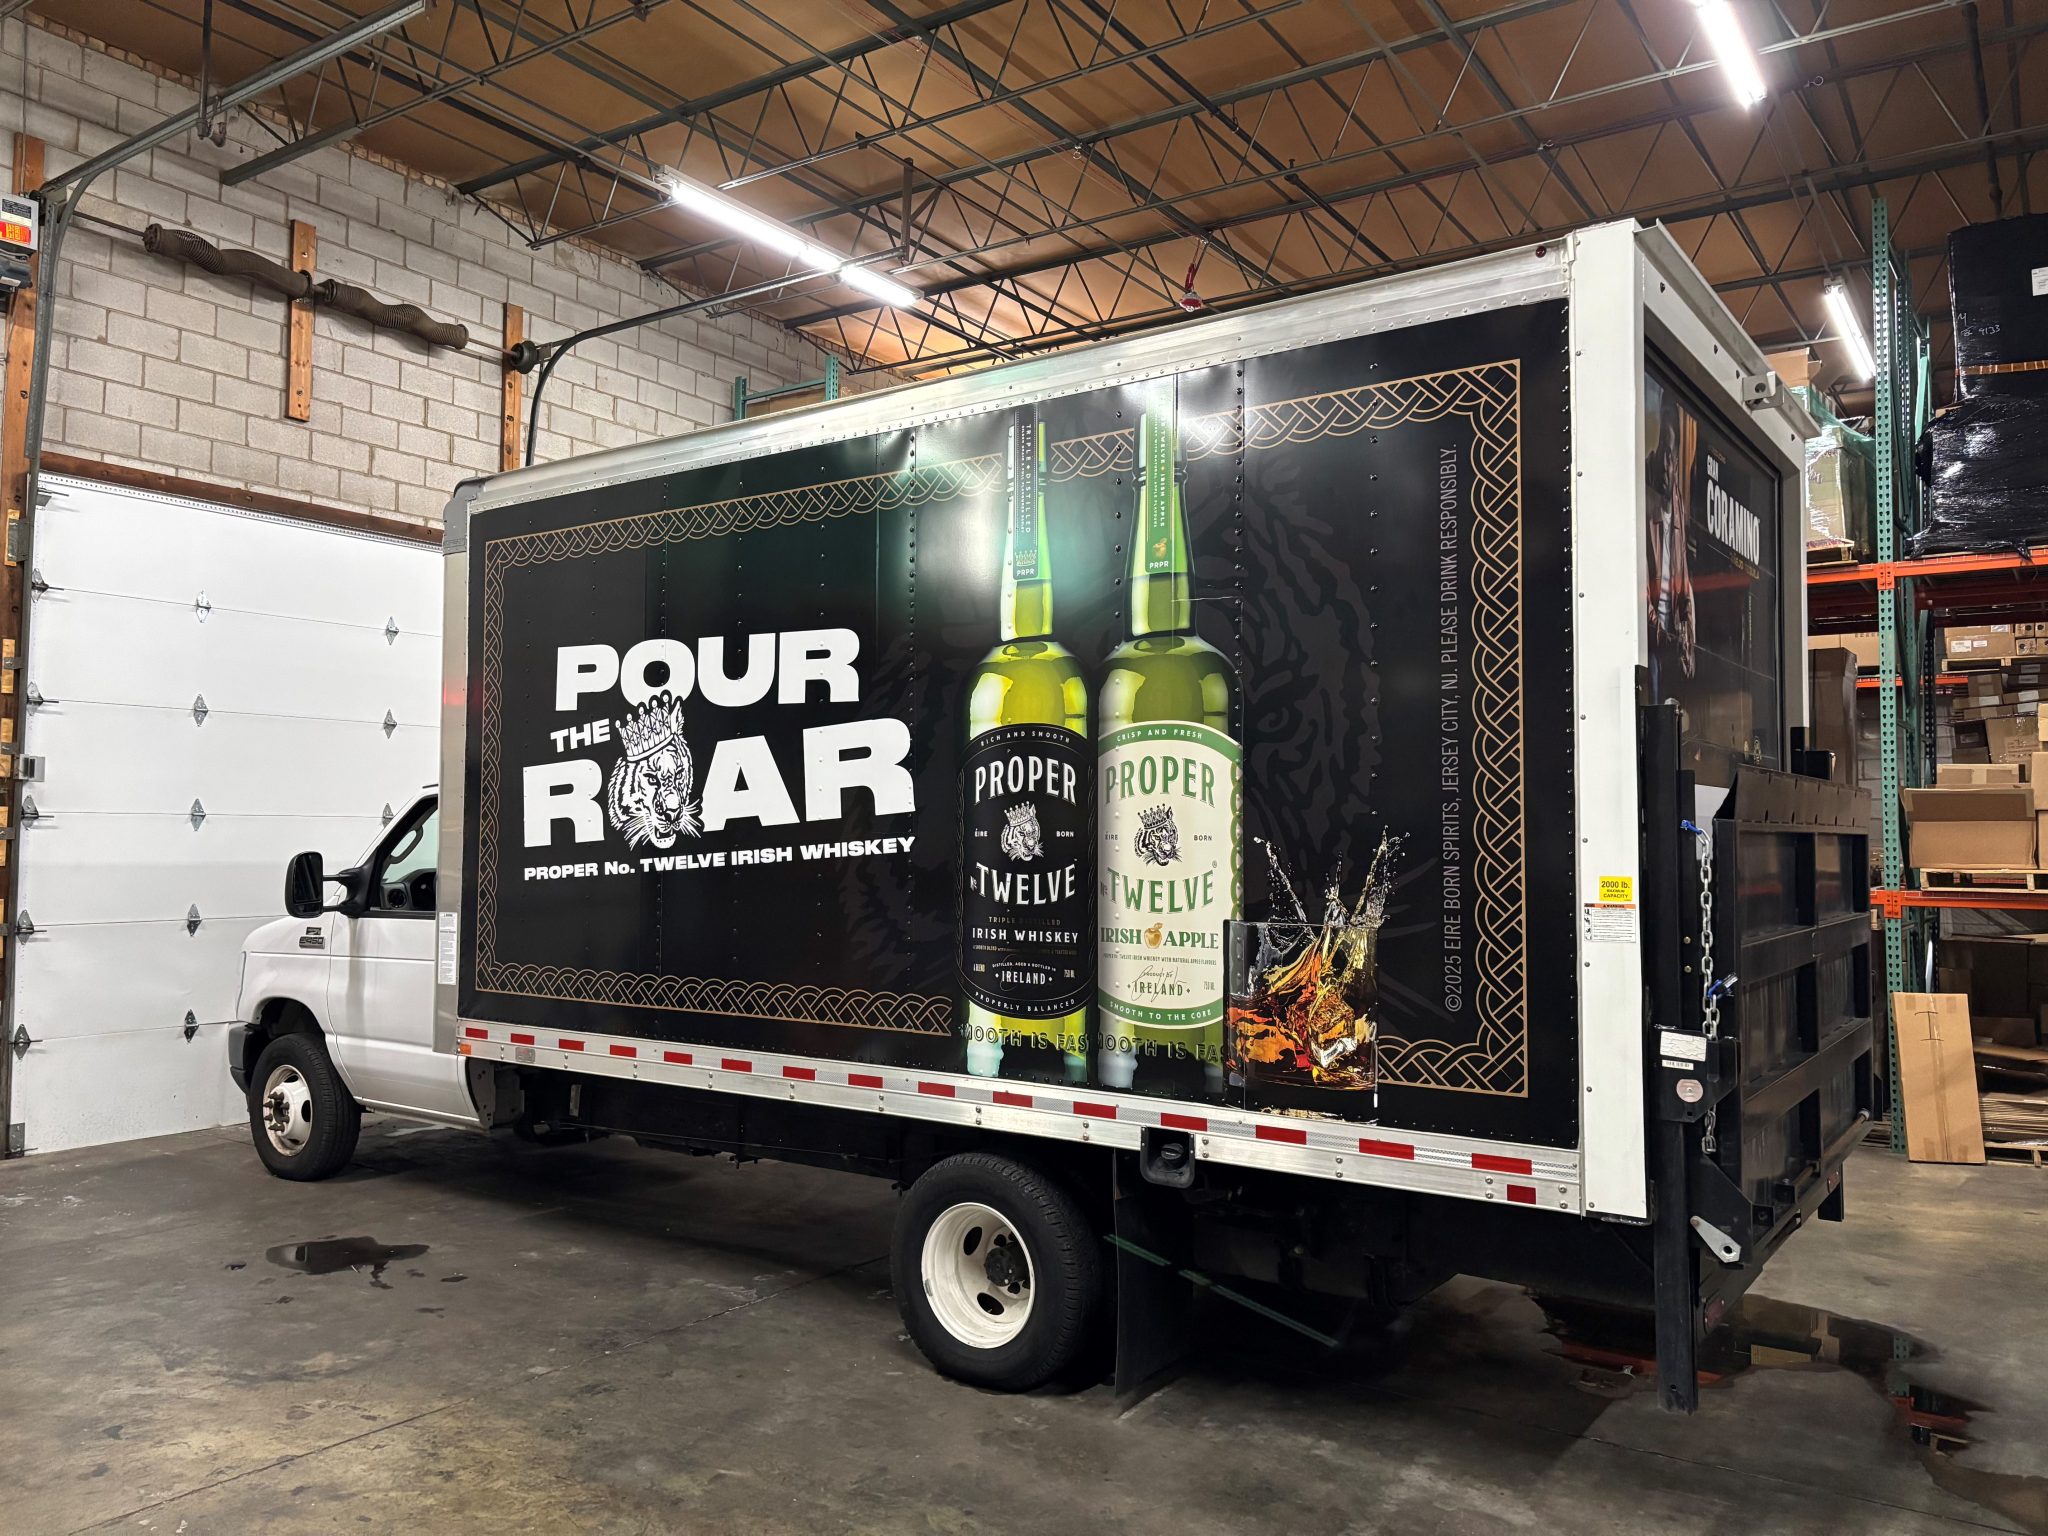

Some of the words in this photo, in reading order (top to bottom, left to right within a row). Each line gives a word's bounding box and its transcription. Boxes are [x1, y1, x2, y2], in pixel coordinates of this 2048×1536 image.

[1440, 443, 1457, 550] RESPONSIBLY.
[1706, 479, 1760, 565] CORAMINO
[1017, 568, 1035, 576] PRPR
[1149, 560, 1169, 569] PRPR
[1440, 553, 1457, 601] DRINK
[1441, 606, 1458, 663] PLEASE
[555, 628, 860, 711] POUR
[1441, 668, 1458, 689] NJ.
[1441, 695, 1461, 732] CITY,
[550, 718, 610, 753] THE
[980, 735, 1000, 746] RICH
[1032, 731, 1070, 743] SMOOTH
[1117, 730, 1142, 742] CRISP
[1174, 729, 1203, 740] FRESH
[1441, 737, 1459, 793] JERSEY
[974, 755, 1077, 806] PROPER
[1105, 755, 1215, 808] PROPER
[1442, 798, 1462, 861] SPIRITS,
[524, 862, 599, 881] PROPER
[604, 860, 635, 876] No.
[640, 852, 725, 873] TWELVE
[731, 847, 792, 866] IRISH
[800, 836, 915, 861] WHISKEY
[1443, 865, 1461, 909] BORN
[1601, 880, 1619, 888] 2000
[1621, 881, 1630, 889] lb.
[988, 916, 1016, 924] TRIPLE
[972, 927, 1007, 940] IRISH
[1014, 930, 1078, 943] WHISKEY
[1100, 927, 1142, 945] IRISH
[1163, 930, 1219, 949] APPLE
[1444, 915, 1461, 950] EIRE
[1002, 970, 1046, 985] IRELAND
[1134, 981, 1183, 996] IRELAND
[975, 991, 1020, 1011] PROPERLY
[1027, 998, 1075, 1012] BALANCED
[1109, 1001, 1143, 1018] SMOOTH
[1149, 1012, 1162, 1020] TO
[1167, 1013, 1186, 1021] THE
[1191, 1008, 1212, 1019] CORE
[1031, 1031, 1048, 1050] IS
[1167, 1040, 1187, 1060] IS
